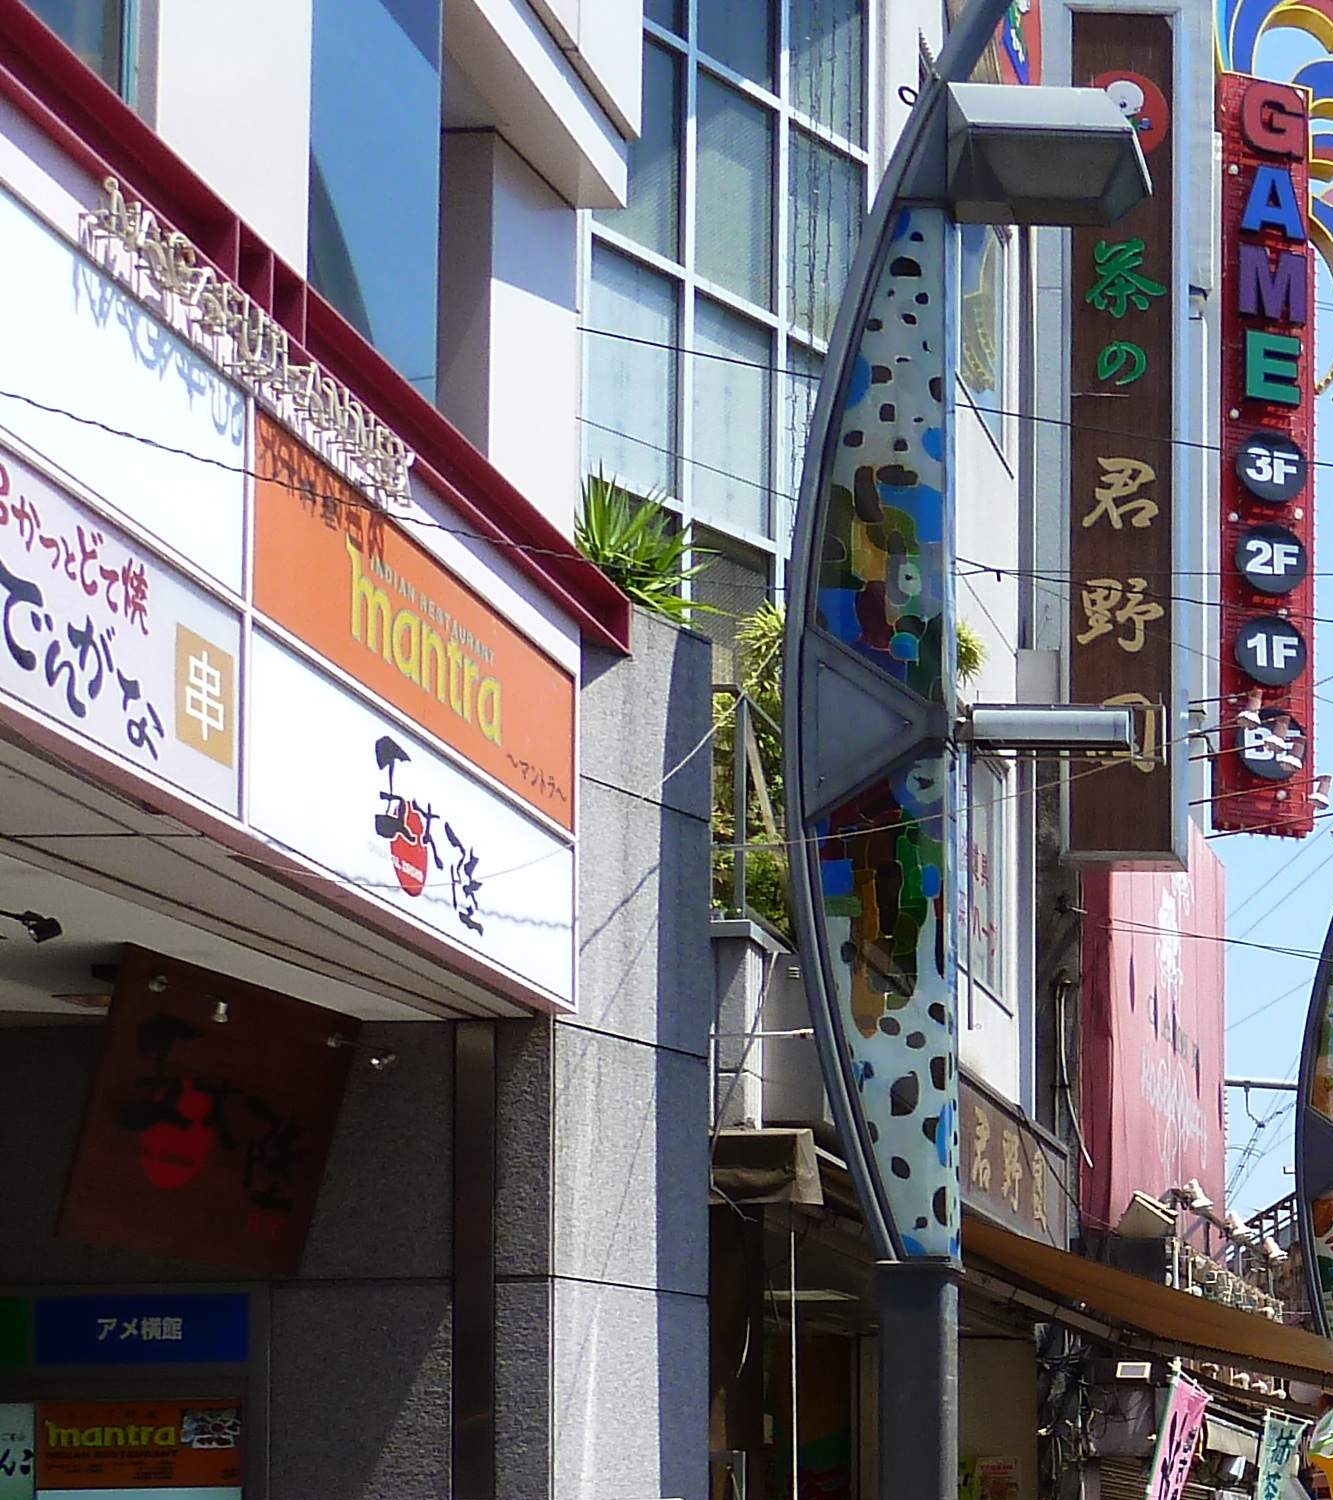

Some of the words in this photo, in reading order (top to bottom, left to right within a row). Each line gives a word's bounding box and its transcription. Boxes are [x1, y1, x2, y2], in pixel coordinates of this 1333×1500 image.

[1239, 81, 1308, 407] GAME
[1245, 447, 1299, 486] 3F
[1245, 537, 1298, 577] 2F
[345, 533, 502, 747] mantra
[420, 592, 497, 669] RESTAURANT
[1247, 632, 1299, 669] 1F
[186, 651, 225, 741] 串
[97, 1317, 184, 1342] アメ横館
[45, 1418, 178, 1449] mantra
